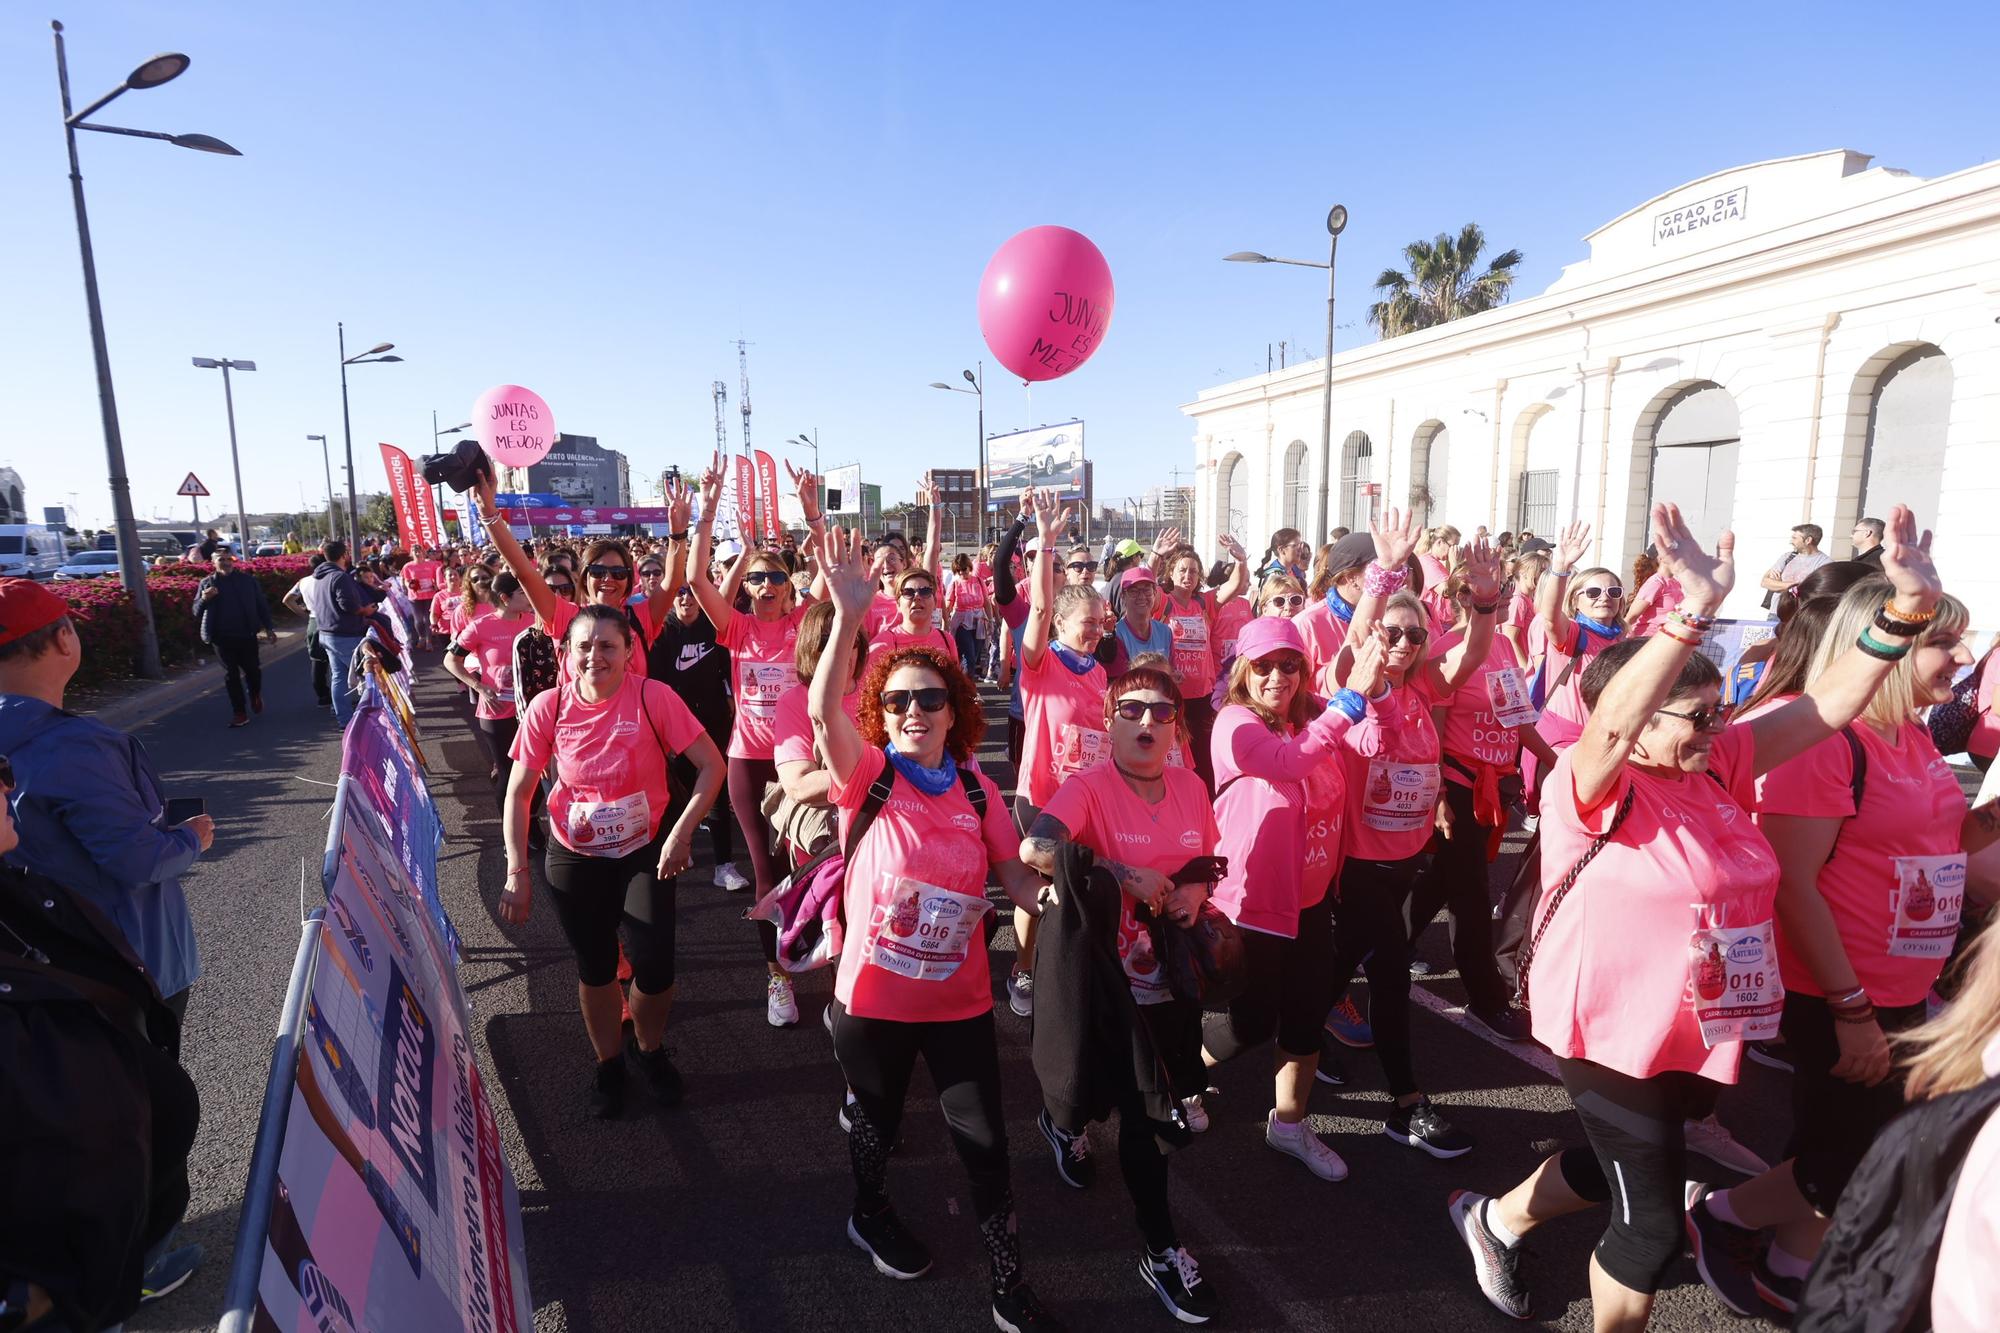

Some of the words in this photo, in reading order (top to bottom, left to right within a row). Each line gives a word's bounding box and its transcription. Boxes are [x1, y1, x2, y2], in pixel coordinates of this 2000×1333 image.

[1663, 206, 1705, 226] GRAO
[1714, 194, 1738, 210] DE
[1659, 207, 1739, 240] VALENCIA
[1071, 335, 1092, 354] ES
[1030, 337, 1080, 374] MEJ
[491, 403, 538, 420] JUNTAS
[510, 420, 527, 431] ES
[495, 435, 543, 450] MEJOR
[545, 452, 565, 460] UERTO
[681, 642, 706, 658] NIKE
[1176, 664, 1198, 672] UMA
[760, 684, 781, 692] 016
[1474, 711, 1494, 725] TU
[1473, 729, 1518, 744] DORS
[1082, 751, 1096, 761] 016
[1394, 790, 1418, 802] 016
[888, 800, 928, 814] OYSHO
[596, 823, 625, 836] 016
[603, 834, 621, 842] 3987
[1114, 832, 1151, 844] OYSHO
[1690, 902, 1727, 929] TU
[919, 922, 950, 938] 016
[1903, 943, 1941, 951] OYSHO
[880, 952, 911, 970] OYSHO
[1730, 971, 1764, 990] 016
[1736, 991, 1759, 1002] 1602
[1704, 1009, 1732, 1018] CARRERA
[1705, 1024, 1731, 1037] OYSHO
[391, 983, 424, 1180] Norauto
[461, 1151, 475, 1177] a
[462, 1176, 492, 1333] ilómetro
